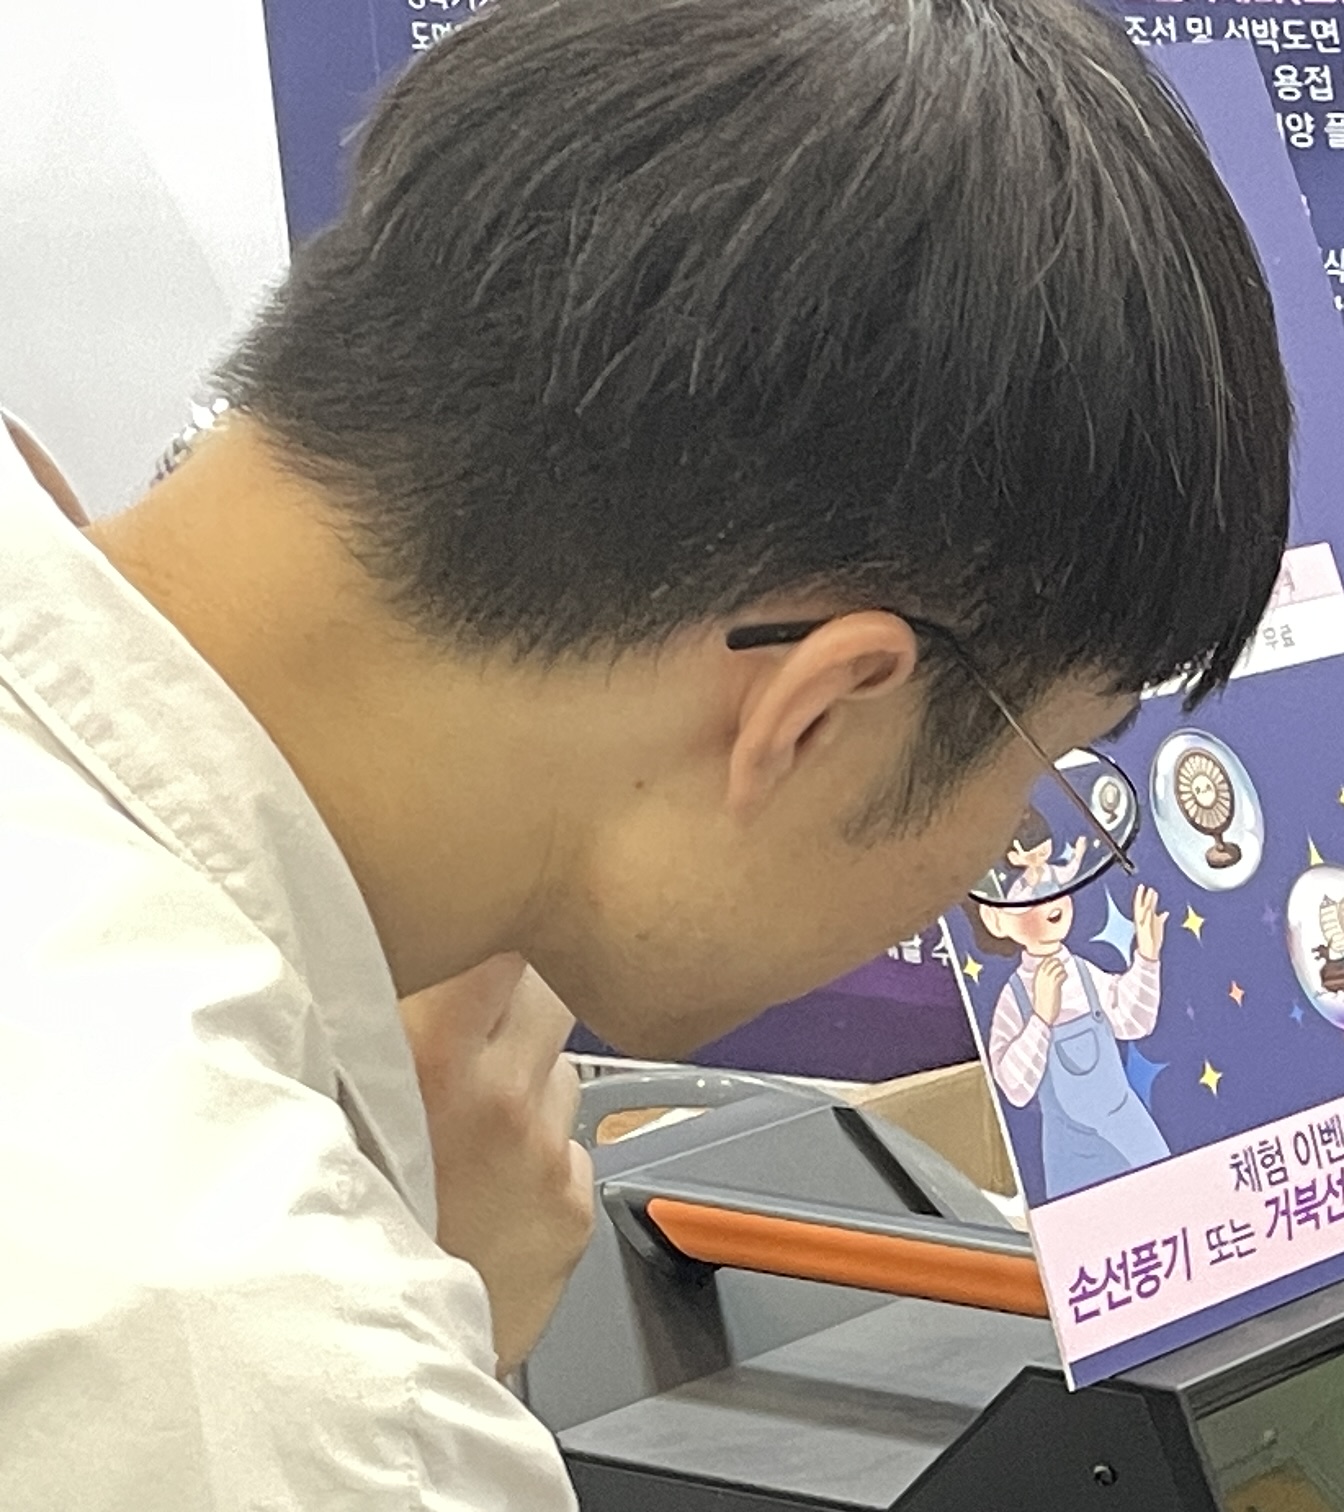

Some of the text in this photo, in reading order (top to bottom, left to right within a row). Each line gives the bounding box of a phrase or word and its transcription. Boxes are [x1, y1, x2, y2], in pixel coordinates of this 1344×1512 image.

[1273, 64, 1334, 102] 용접
[1276, 111, 1315, 149] 양
[1229, 1134, 1290, 1193] 체험
[1068, 1226, 1192, 1325] 손선풍기
[1205, 1218, 1258, 1267] 또는
